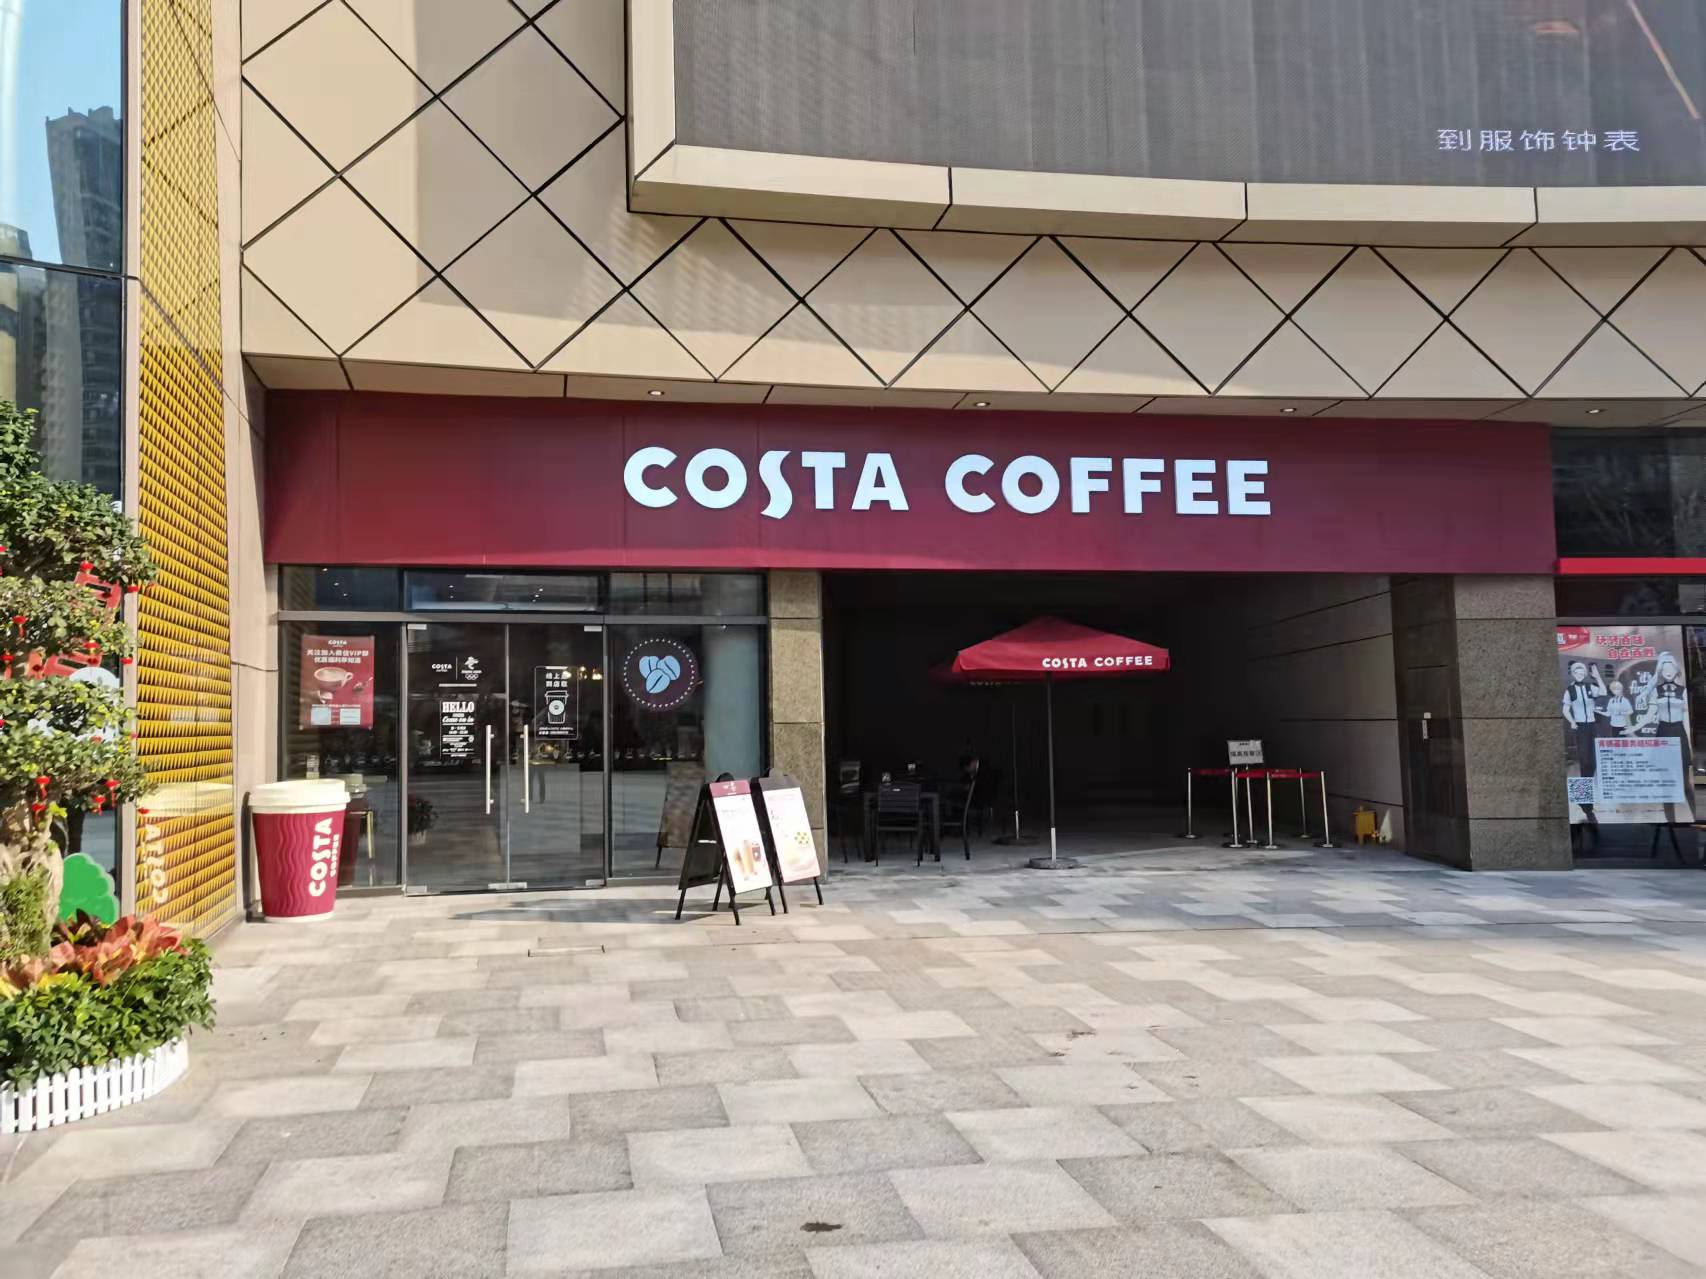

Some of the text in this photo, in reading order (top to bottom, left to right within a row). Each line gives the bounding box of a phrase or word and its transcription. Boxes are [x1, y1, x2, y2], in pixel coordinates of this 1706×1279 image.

[1437, 129, 1640, 152] 到服饰钟表
[623, 446, 1272, 519] COSTA COFFEE
[1042, 656, 1153, 669] COSTA COFFEE
[442, 701, 474, 713] HELLO
[308, 817, 333, 896] COSTA
